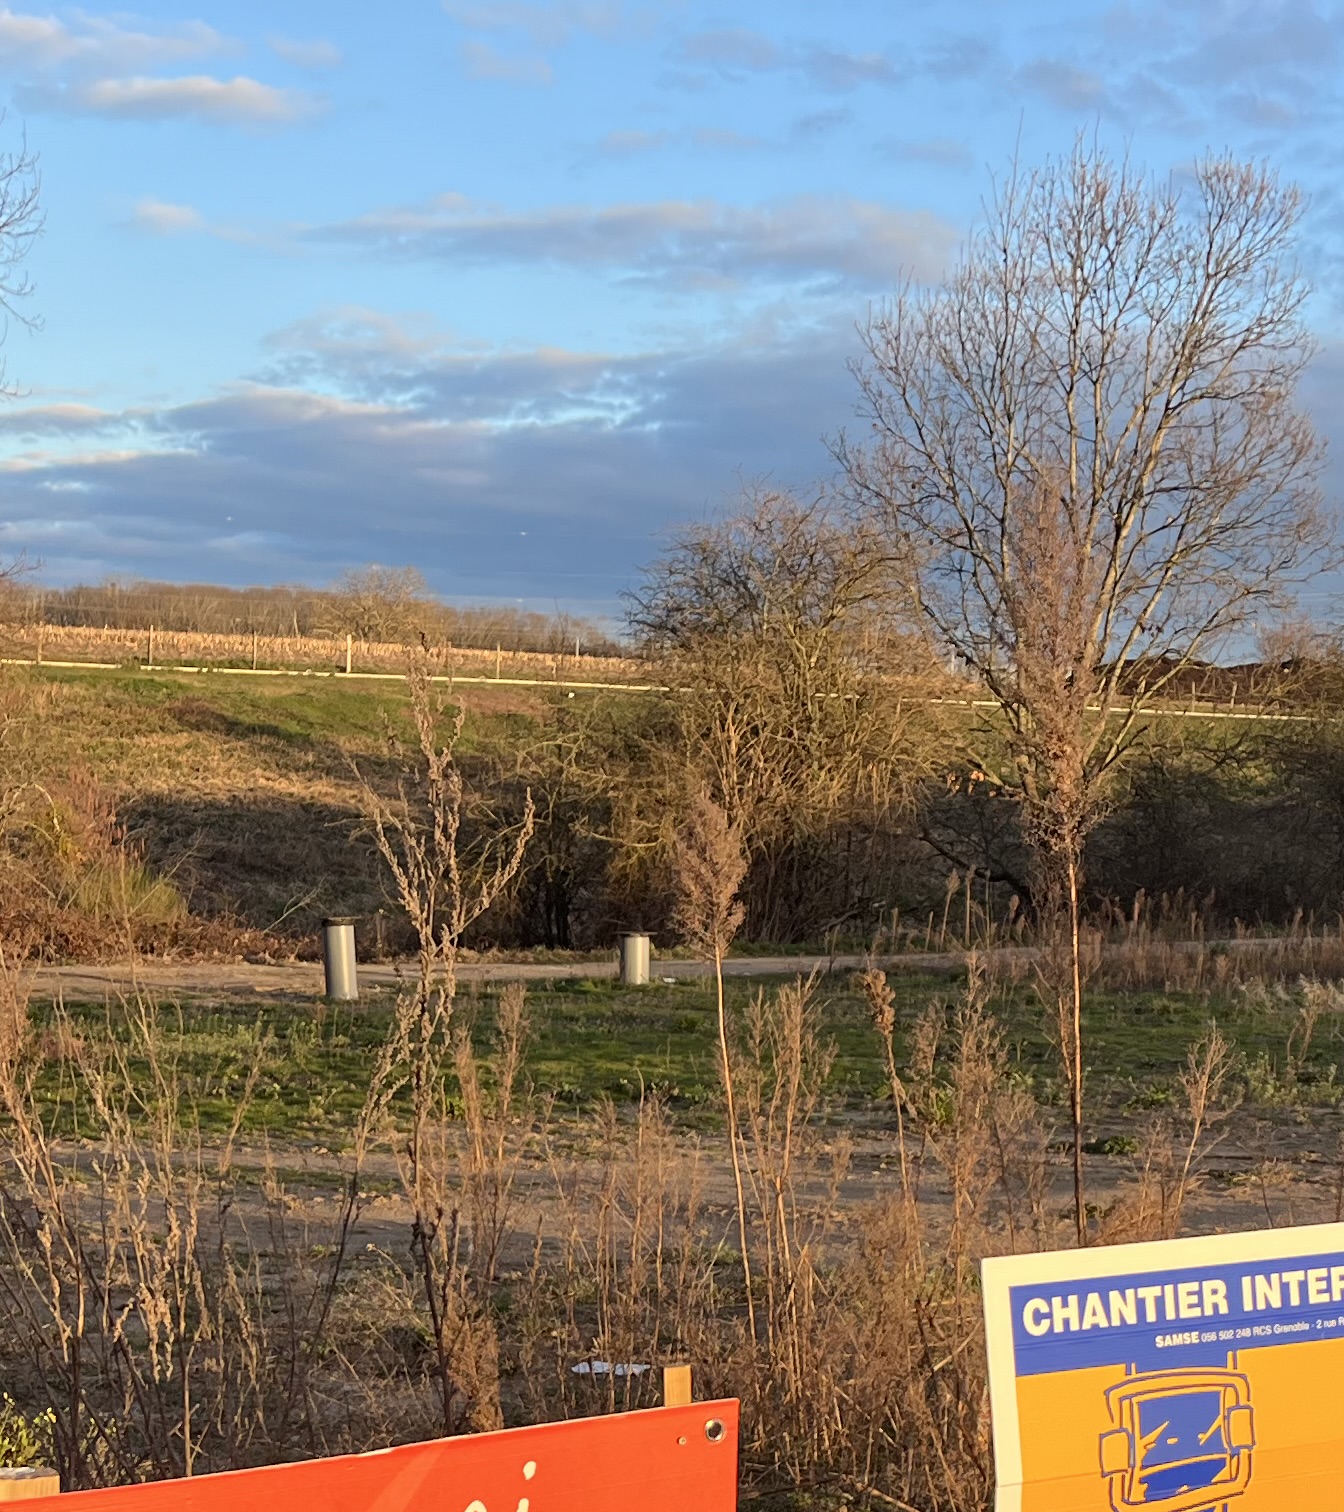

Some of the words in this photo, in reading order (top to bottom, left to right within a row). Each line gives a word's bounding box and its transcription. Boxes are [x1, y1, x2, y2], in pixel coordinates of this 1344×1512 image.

[1022, 1279, 1228, 1337] CHANTIER
[1155, 1331, 1200, 1348] SAMSE
[1253, 1325, 1272, 1337] RCS
